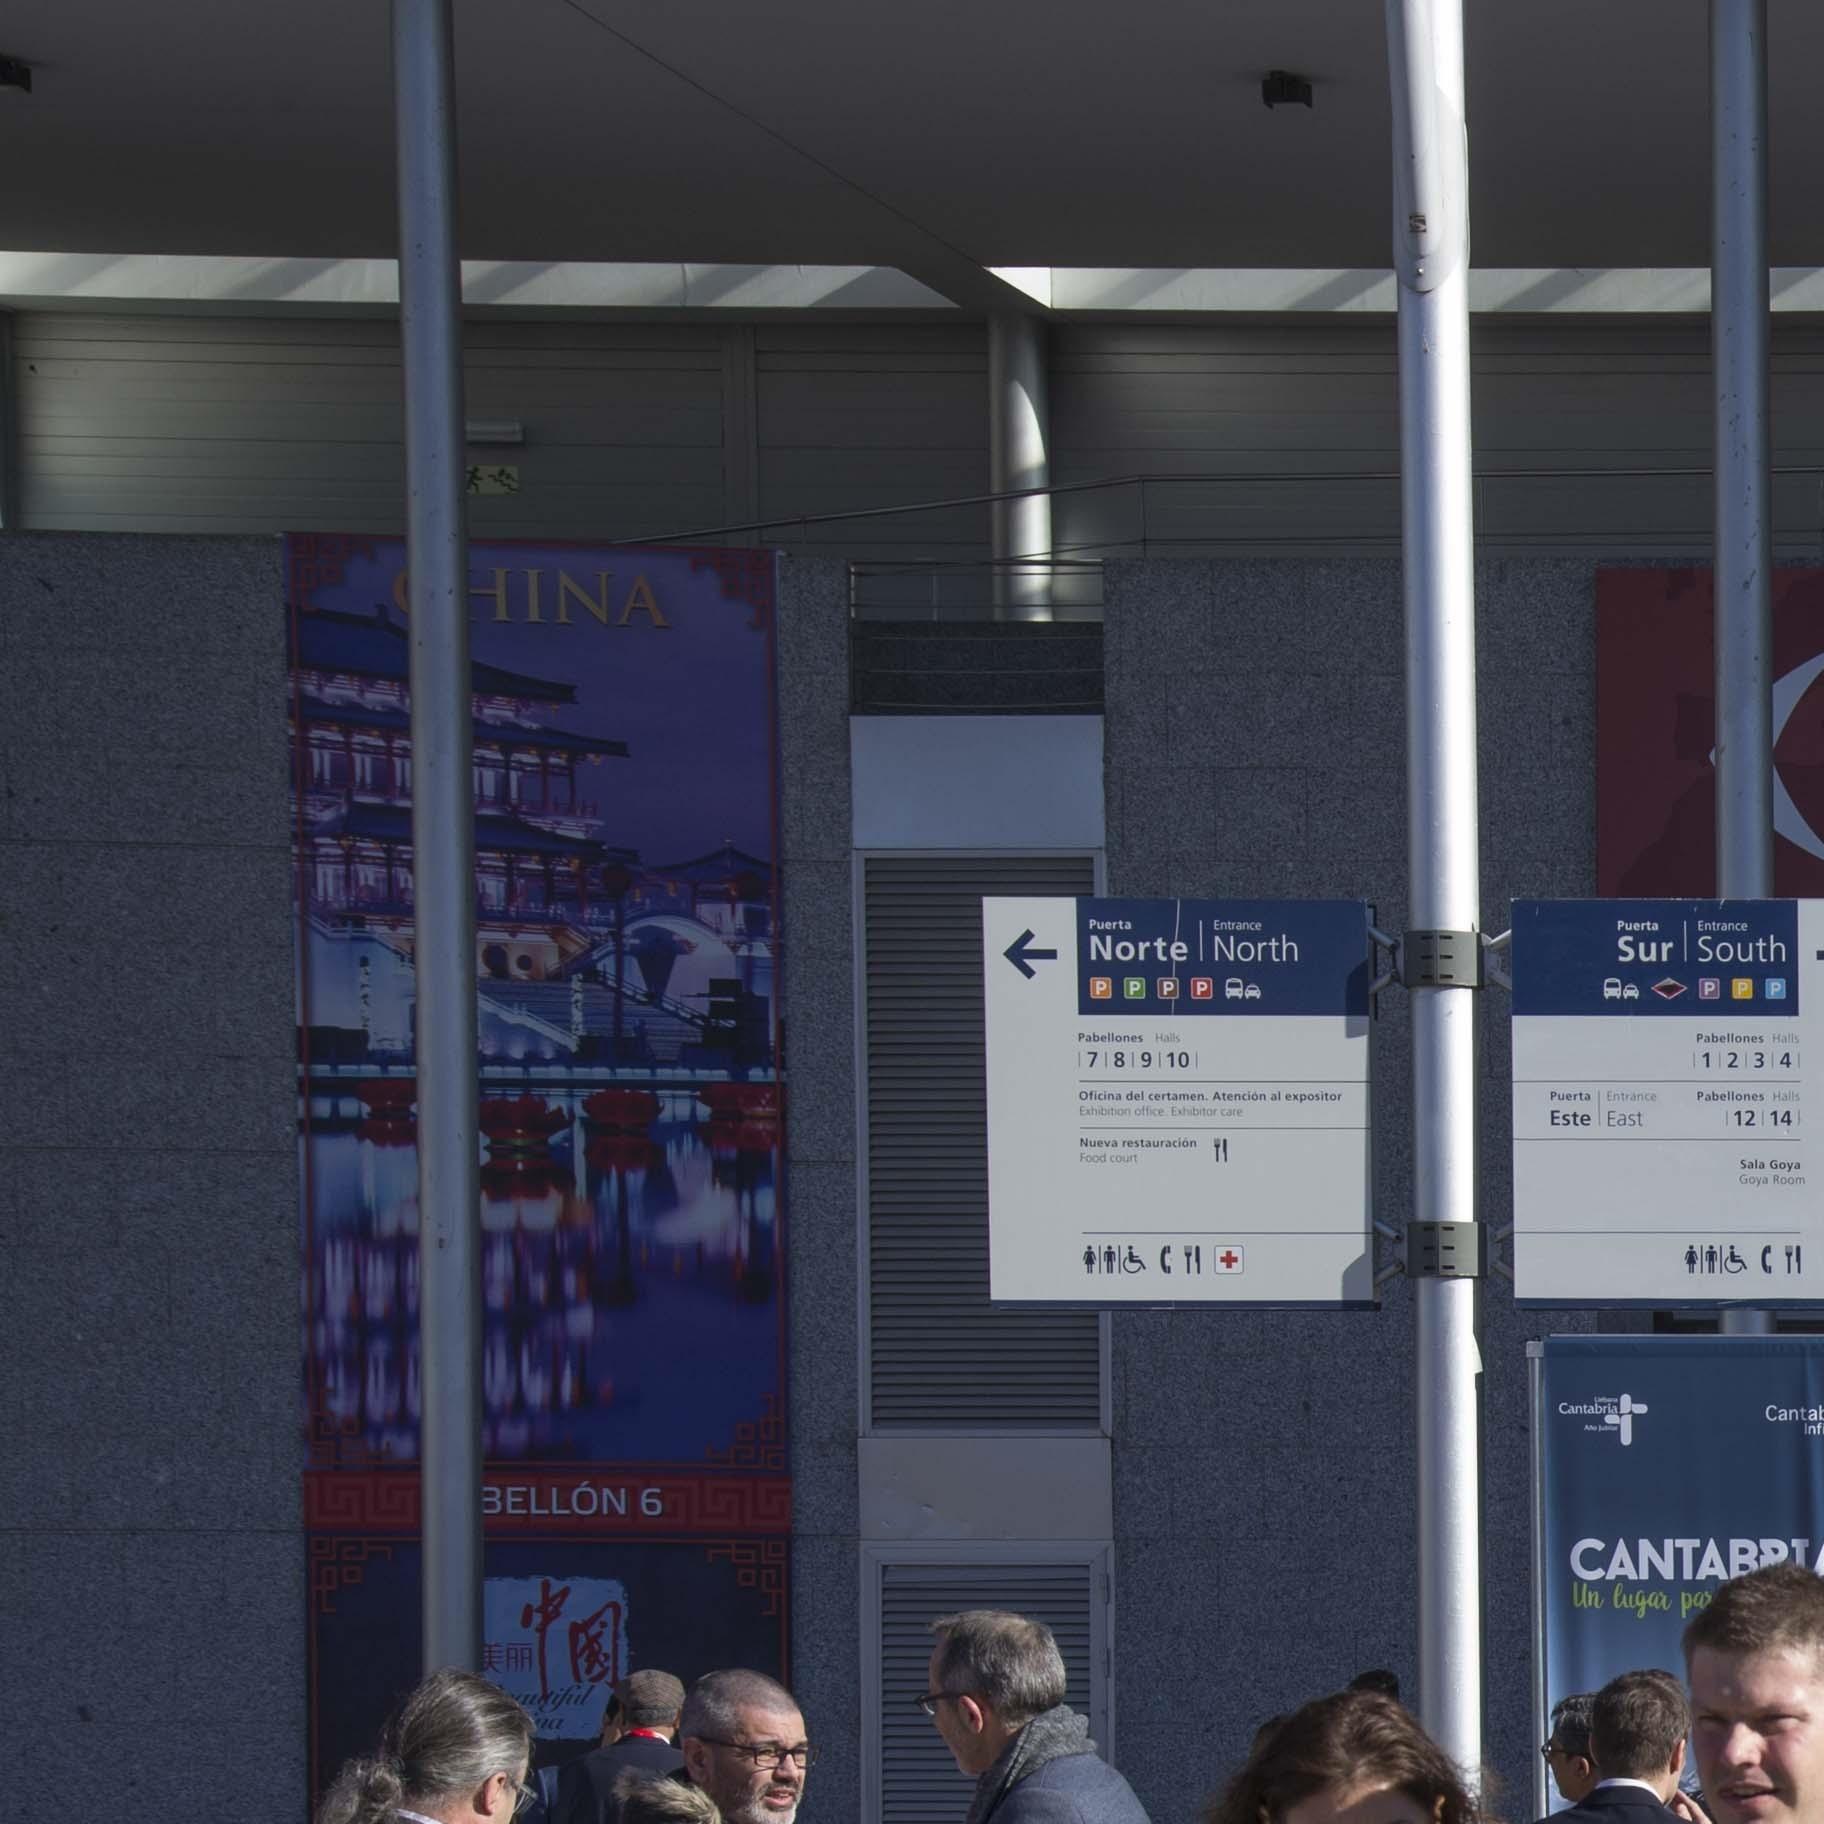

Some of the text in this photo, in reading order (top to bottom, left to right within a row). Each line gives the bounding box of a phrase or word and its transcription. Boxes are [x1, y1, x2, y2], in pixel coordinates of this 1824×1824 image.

[391, 566, 672, 630] HINA
[1088, 918, 1133, 932] Puerta
[1213, 919, 1263, 932] Entrance
[1617, 920, 1659, 931] Puerta
[1697, 920, 1748, 931] Entrance
[1089, 934, 1189, 963] Norte
[1213, 934, 1299, 963] North
[1617, 936, 1673, 963] Sur
[1697, 934, 1787, 963] South
[1078, 1031, 1181, 1044] Pabellones Halls
[1696, 1032, 1800, 1044] Pabellones Halls
[1086, 1051, 1190, 1068] 7 8 9 10
[1702, 1052, 1792, 1068] 1 2 3 4
[1078, 1090, 1122, 1102] Oficina
[1125, 1090, 1145, 1102] del
[1212, 1089, 1267, 1102] Atención
[1270, 1090, 1282, 1102] al
[1285, 1090, 1342, 1104] expositor
[1549, 1090, 1592, 1102] Puerta
[1606, 1091, 1657, 1102] Entrance
[1696, 1090, 1800, 1102] Pabellones Halls
[1079, 1105, 1132, 1118] Exhibition
[1171, 1105, 1223, 1118] Exhibitor
[1226, 1107, 1243, 1118] care
[1550, 1110, 1592, 1127] Este
[1606, 1110, 1643, 1127] East
[1734, 1110, 1792, 1127] 12 14
[1079, 1136, 1197, 1149] Nueva restauración
[1079, 1152, 1138, 1164] Food court
[1740, 1159, 1801, 1173] Sala Goya
[1739, 1174, 1806, 1188] Goya Room
[1558, 1402, 1619, 1416] Cantabria
[641, 1488, 662, 1517] 6
[1572, 1583, 1713, 1618] Un lugar par
